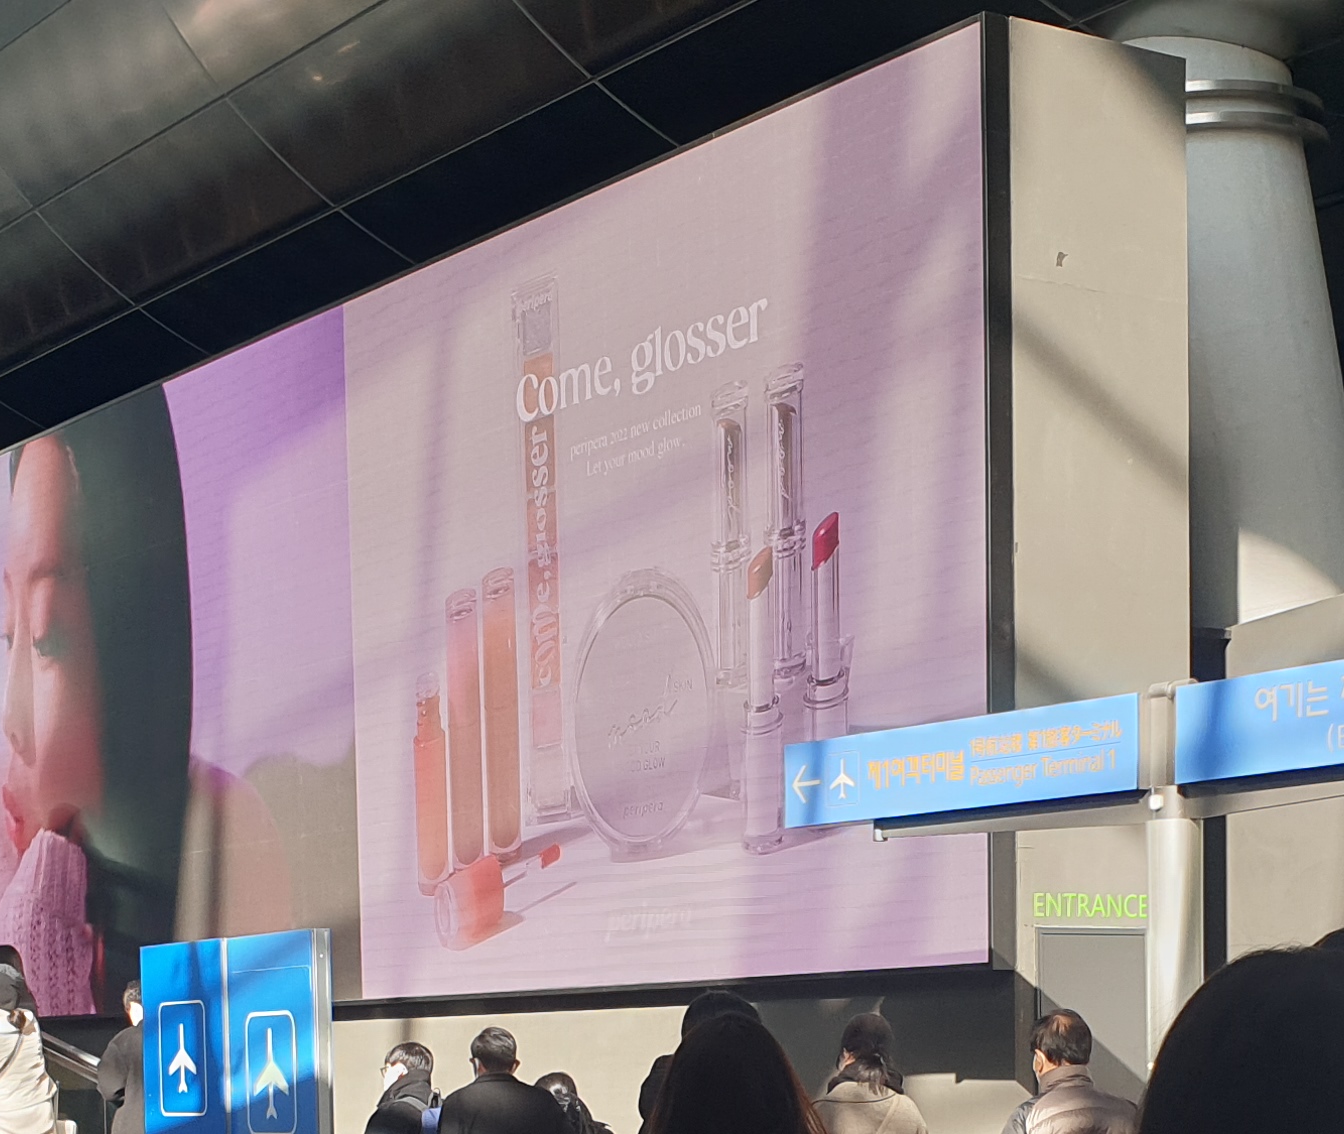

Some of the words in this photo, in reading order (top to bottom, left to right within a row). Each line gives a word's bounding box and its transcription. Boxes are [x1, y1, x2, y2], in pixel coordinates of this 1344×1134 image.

[516, 356, 621, 422] Come,
[631, 298, 768, 395] glosser
[570, 435, 608, 461] peripera
[630, 420, 651, 439] new
[652, 404, 702, 431] collection
[586, 459, 603, 477] Let
[603, 453, 626, 476] your
[627, 440, 656, 463] mood
[1254, 679, 1329, 722] 여기는
[867, 749, 965, 791] 제1여객터미널
[969, 762, 1038, 788] Passenger
[1040, 748, 1104, 778] Terminal
[1108, 748, 1116, 770] 1
[1033, 892, 1148, 918] ENTRANCE
